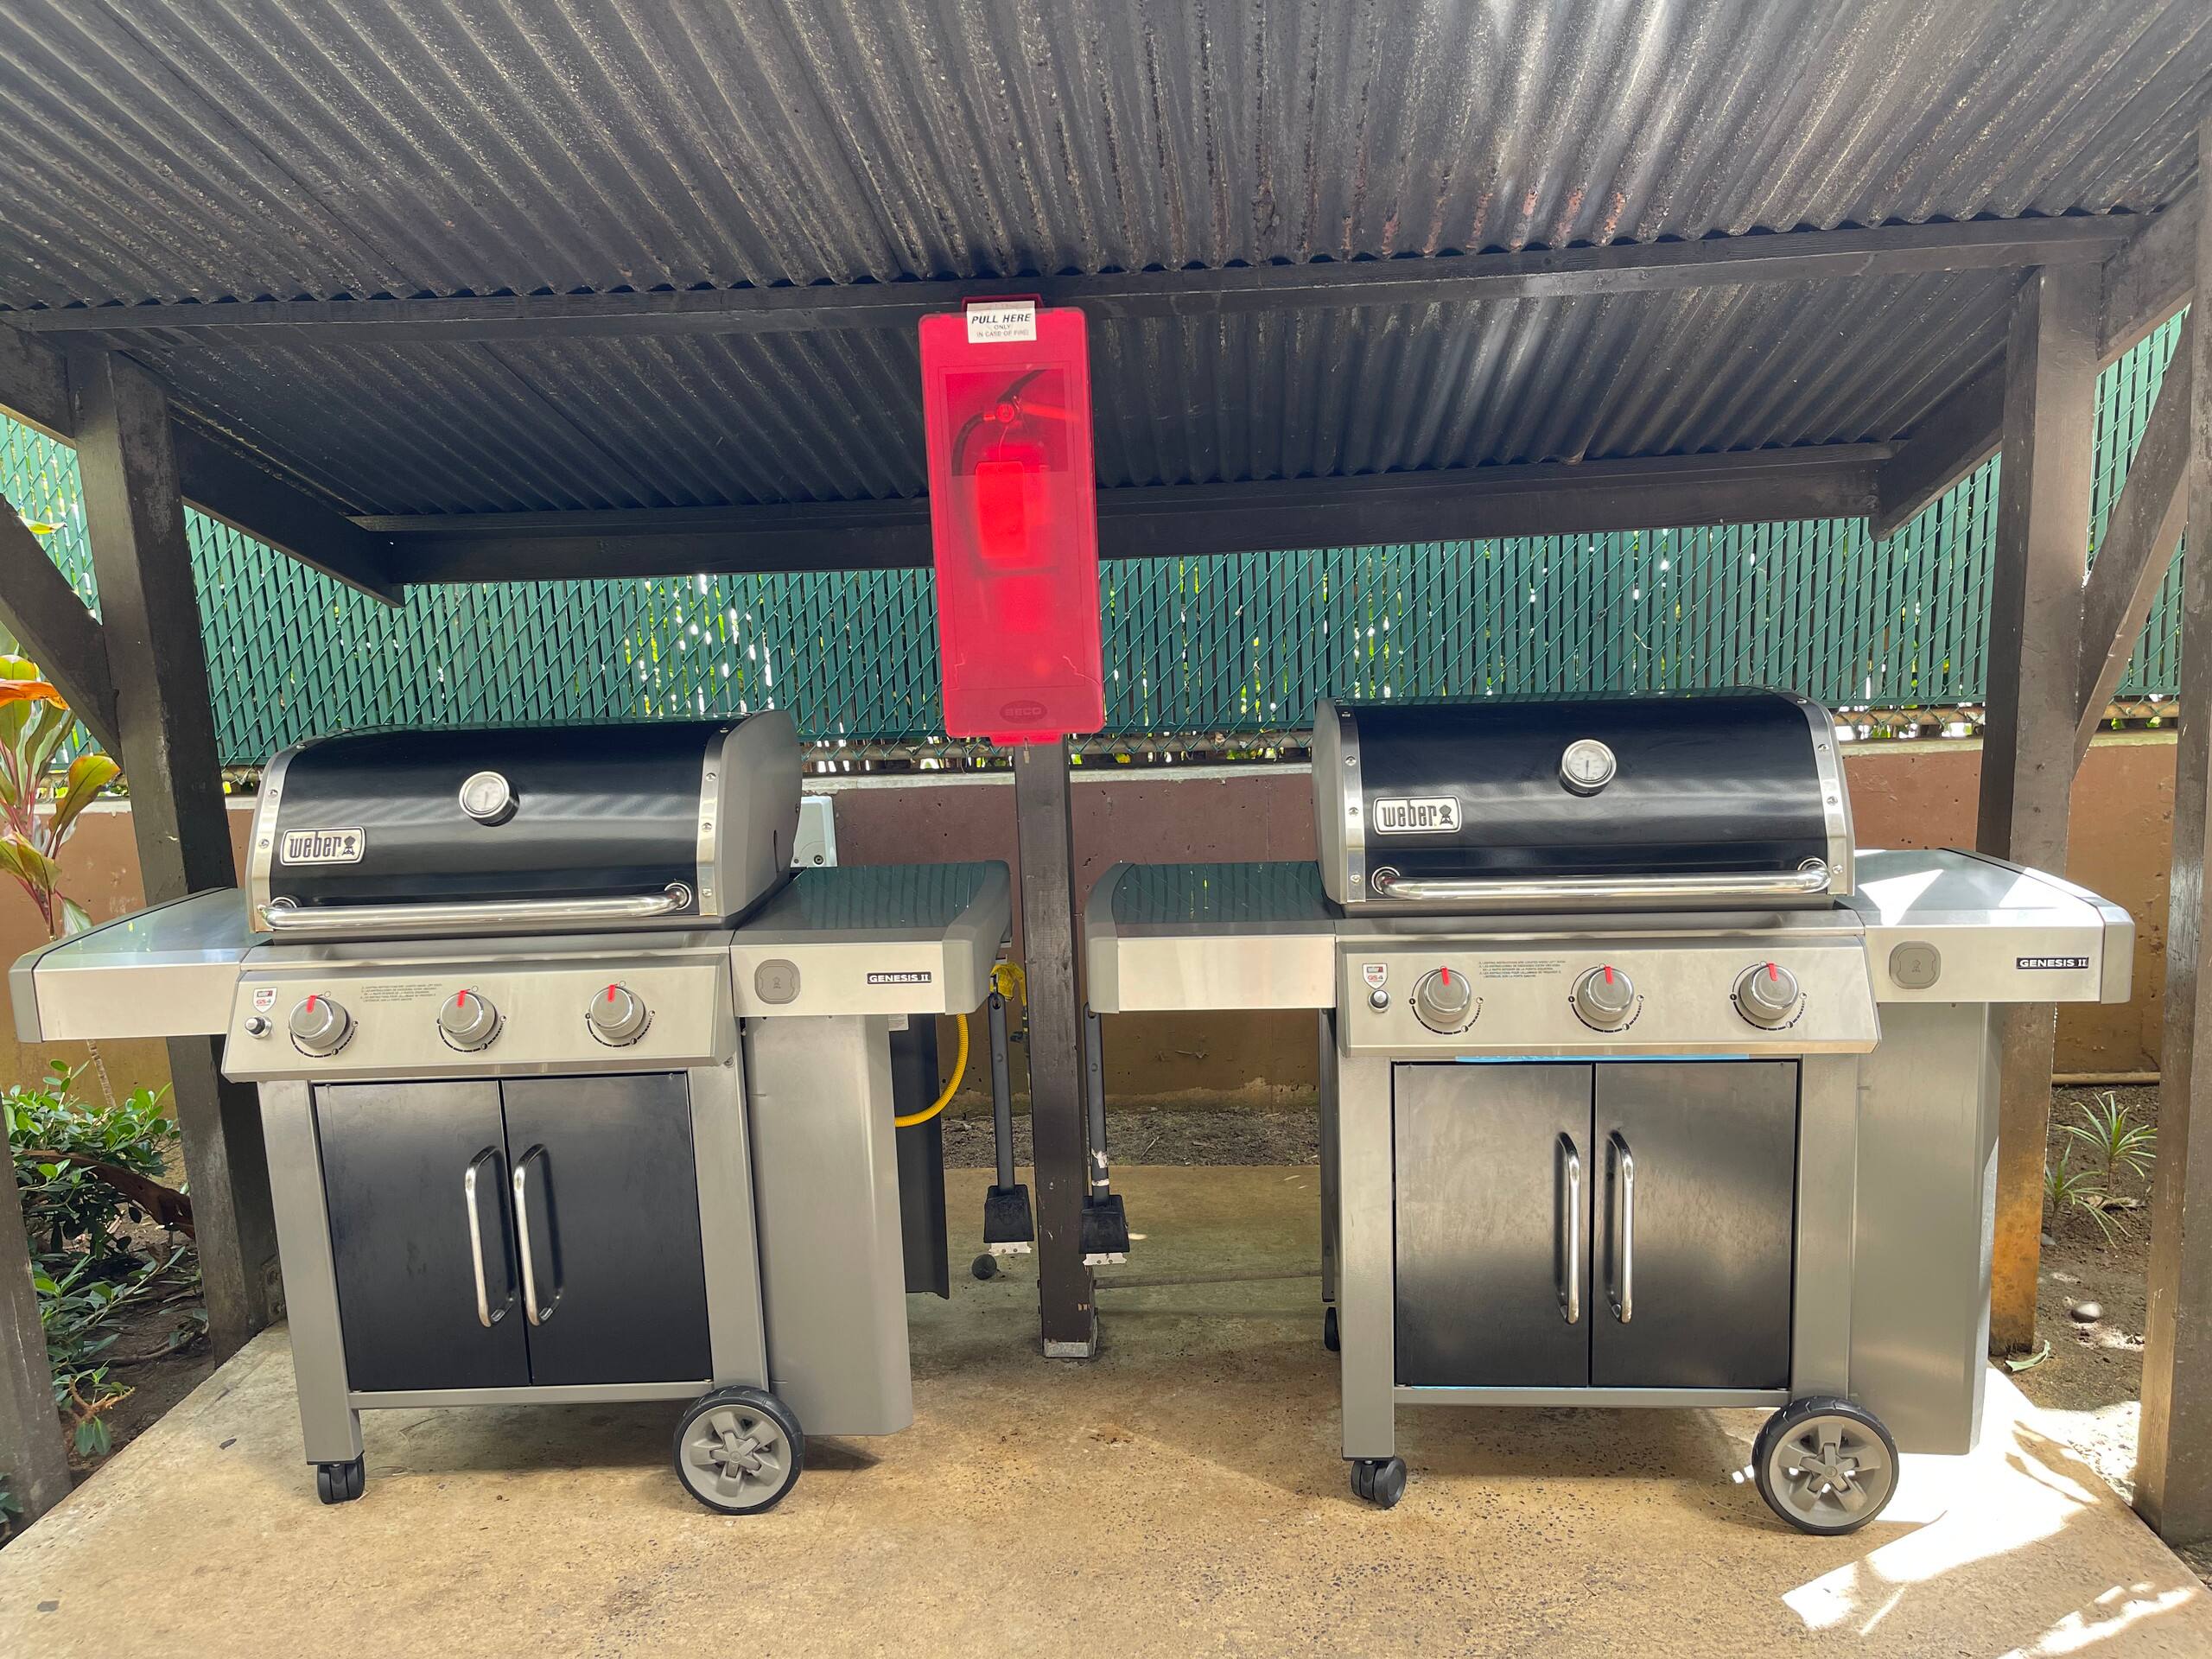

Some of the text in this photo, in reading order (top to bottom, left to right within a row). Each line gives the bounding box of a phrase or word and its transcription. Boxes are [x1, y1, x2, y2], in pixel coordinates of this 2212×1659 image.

[971, 314, 1032, 324] PULL HERE
[1382, 799, 1438, 827] weber
[289, 830, 342, 859] weber
